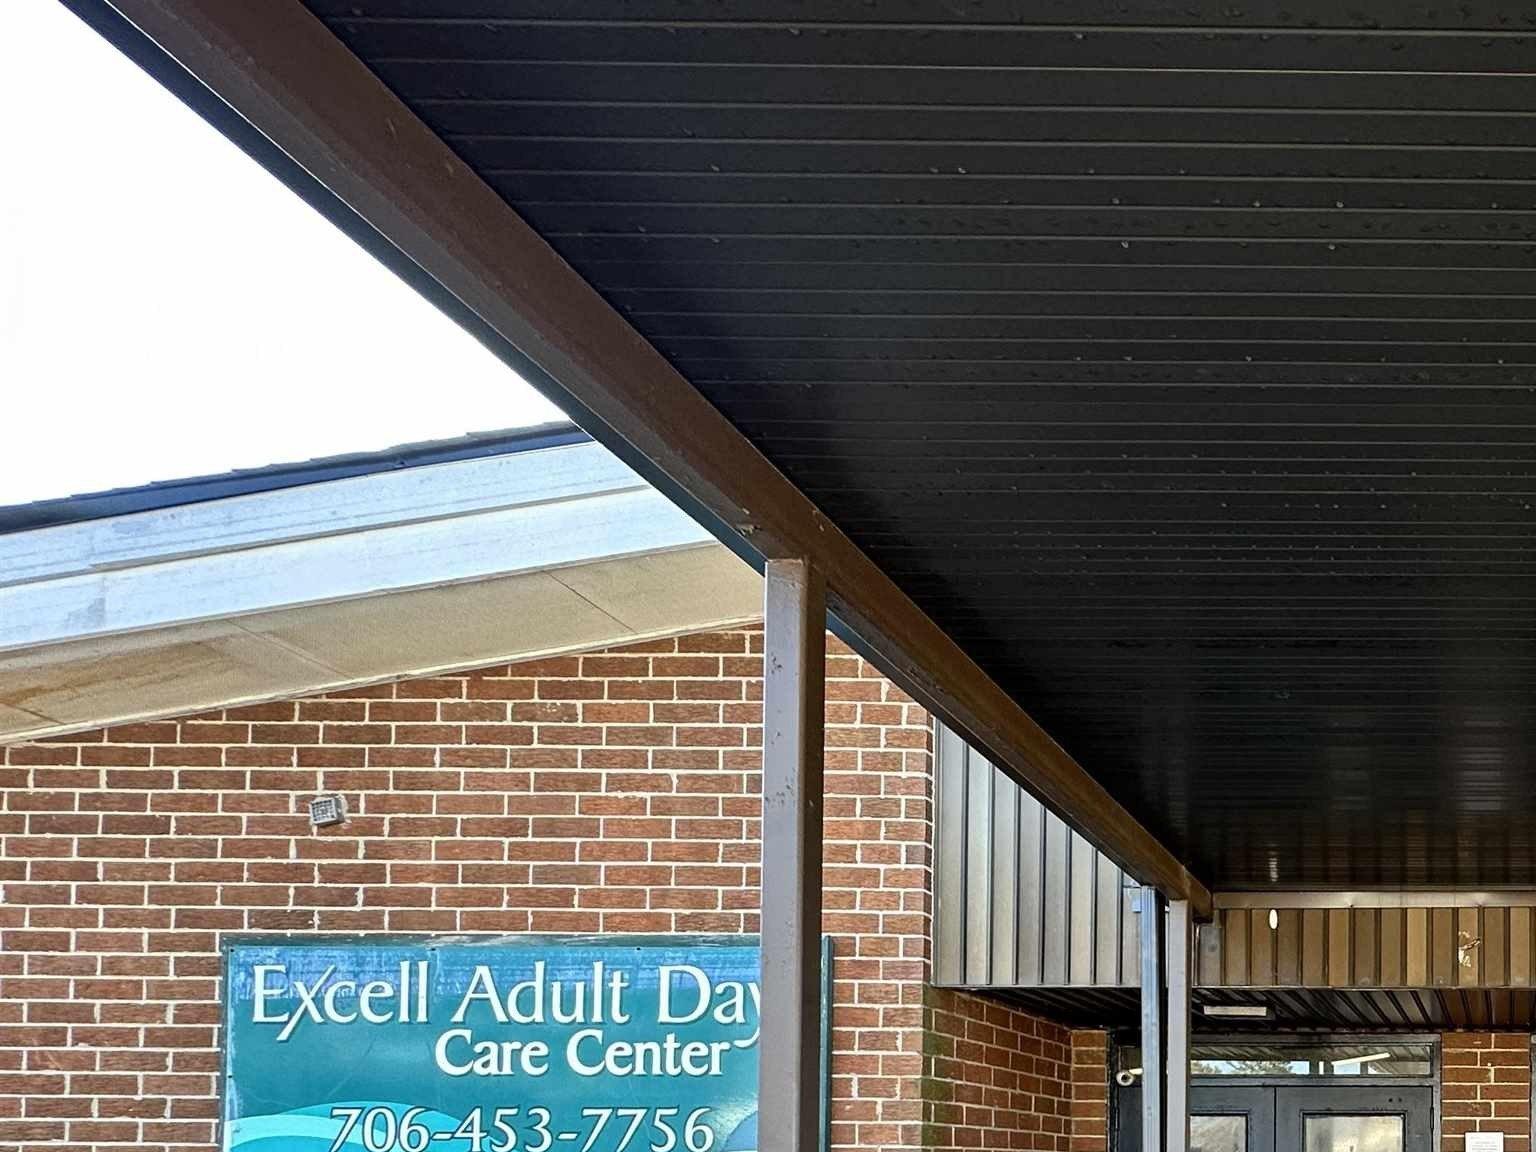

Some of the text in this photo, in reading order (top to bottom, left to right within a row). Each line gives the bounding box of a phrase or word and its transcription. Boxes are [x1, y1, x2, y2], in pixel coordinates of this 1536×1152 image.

[252, 961, 428, 1042] Excell
[451, 960, 630, 1025] Adult
[434, 1028, 732, 1077] Care Center
